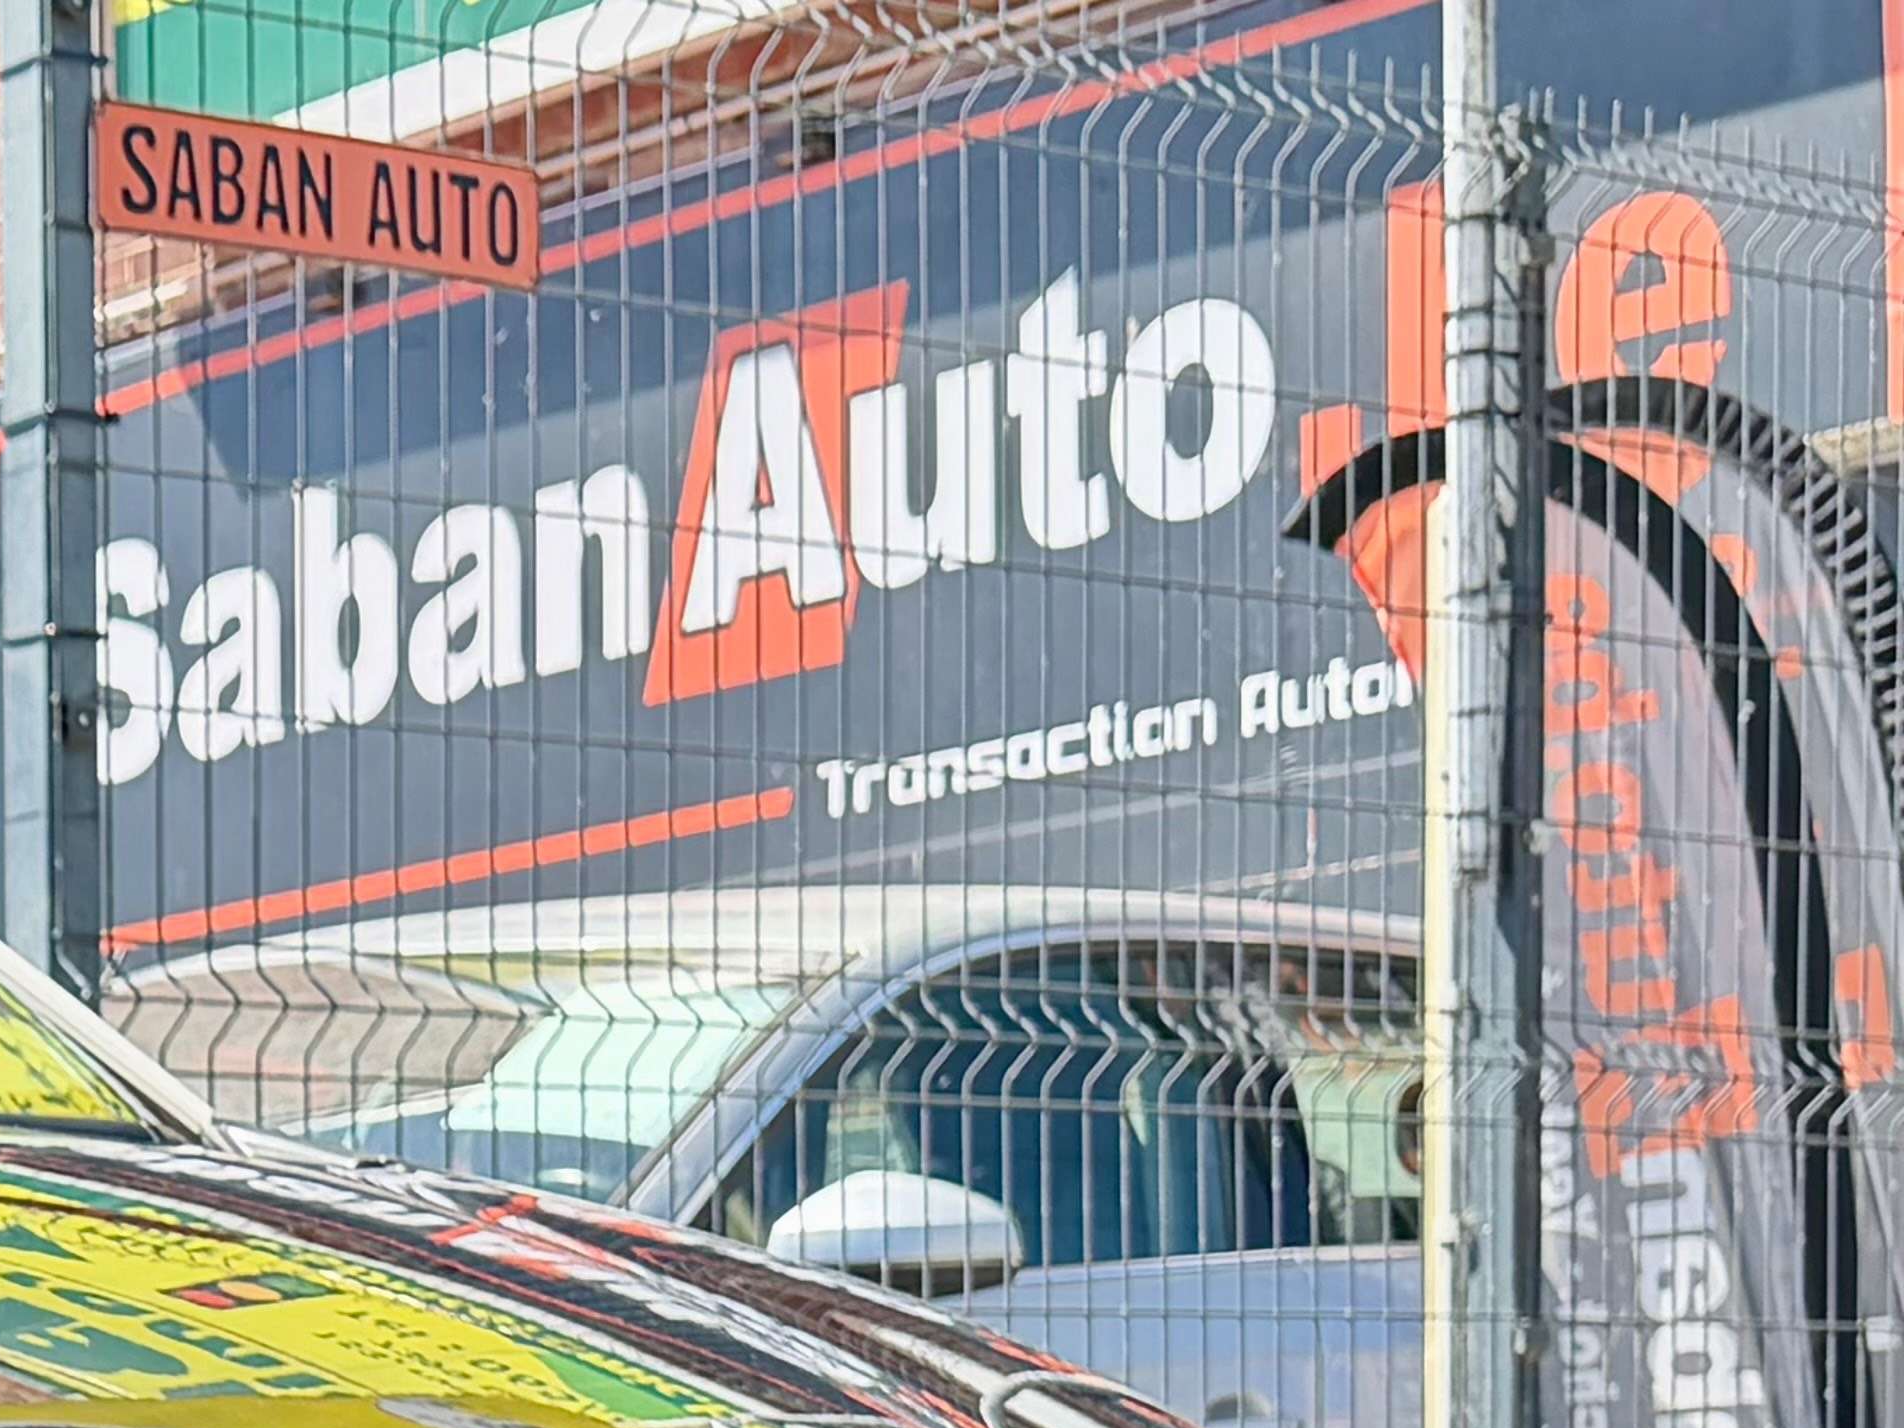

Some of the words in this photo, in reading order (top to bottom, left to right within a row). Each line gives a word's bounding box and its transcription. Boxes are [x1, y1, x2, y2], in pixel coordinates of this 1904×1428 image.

[119, 122, 335, 243] SABAN
[367, 159, 521, 269] AUTO
[814, 696, 1219, 820] Transaction
